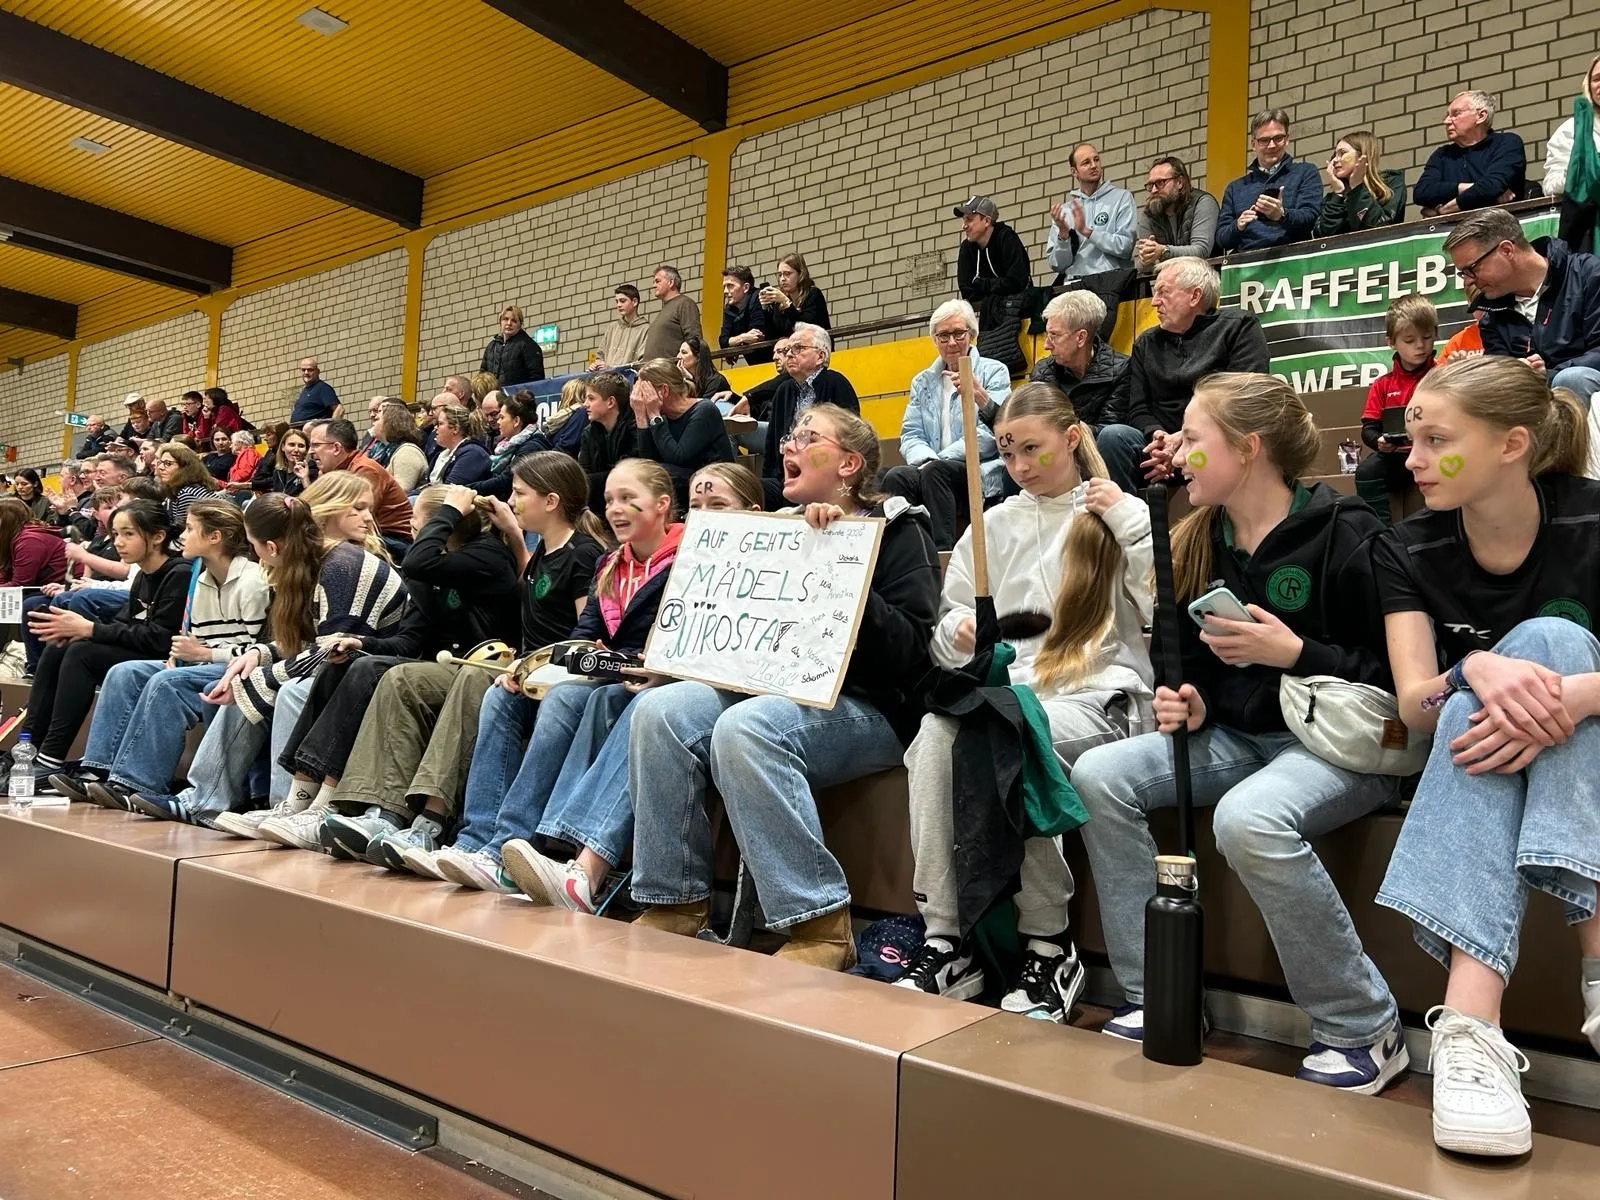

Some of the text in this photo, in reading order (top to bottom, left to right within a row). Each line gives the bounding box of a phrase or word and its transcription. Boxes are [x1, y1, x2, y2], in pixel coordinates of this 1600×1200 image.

[1406, 406, 1423, 423] CR
[999, 432, 1015, 448] CR
[694, 481, 713, 494] CR
[697, 528, 804, 553] AUF GEHT'S
[681, 560, 814, 602] MÄDELS
